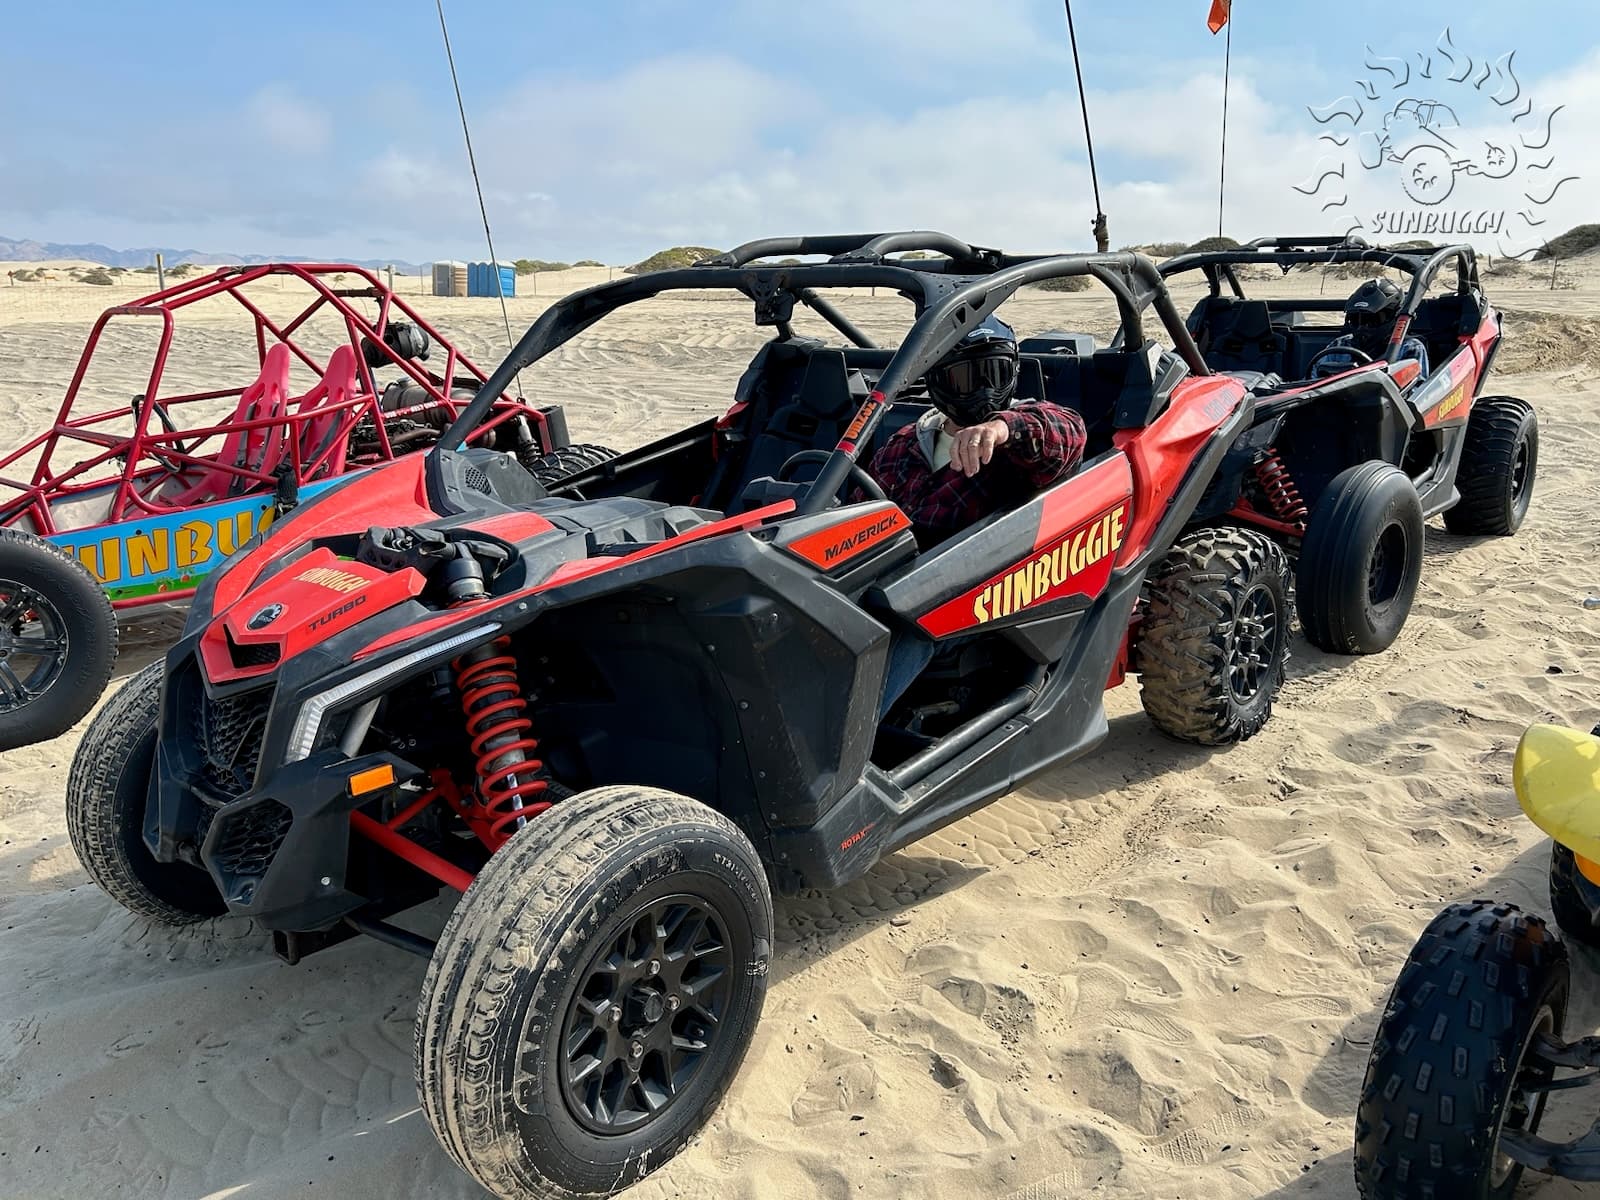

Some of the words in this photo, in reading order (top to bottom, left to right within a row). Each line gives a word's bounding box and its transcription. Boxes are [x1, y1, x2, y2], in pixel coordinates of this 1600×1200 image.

[823, 510, 898, 561] MAVERICK
[973, 505, 1125, 624] SUNBUGGIE
[308, 595, 366, 631] TURBO
